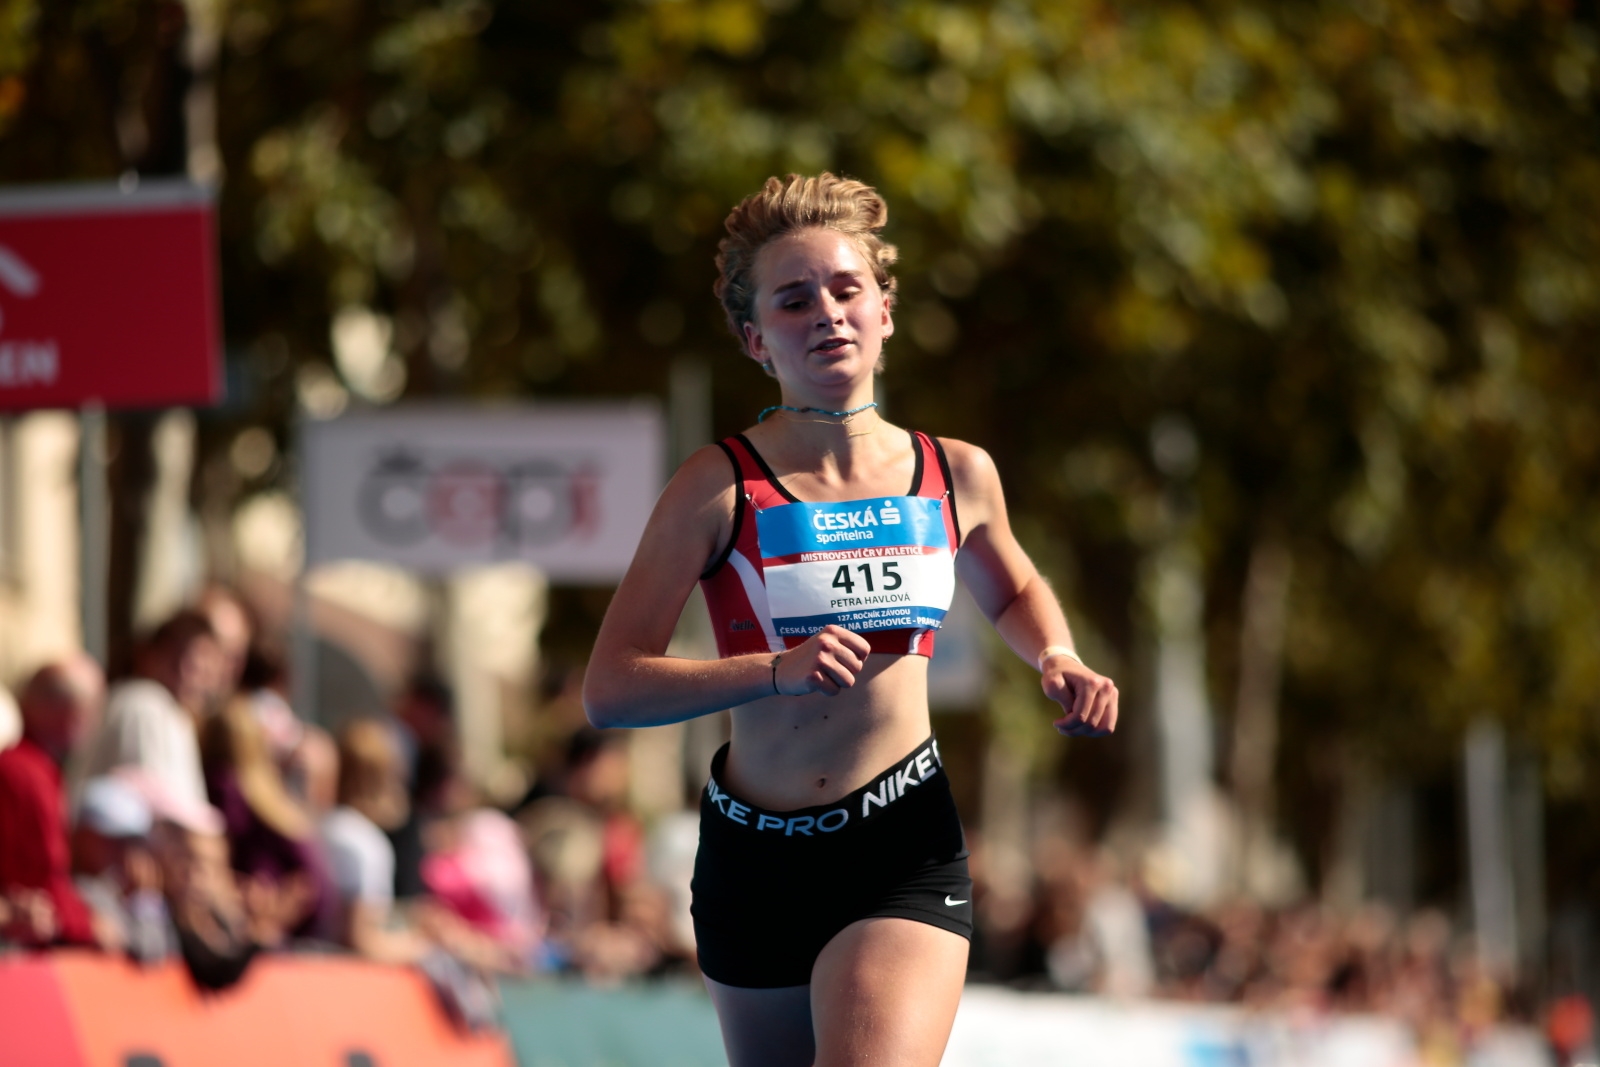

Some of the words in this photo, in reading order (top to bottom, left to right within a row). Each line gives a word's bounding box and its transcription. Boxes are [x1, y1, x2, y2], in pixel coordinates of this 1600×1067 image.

[813, 506, 879, 531] ČESKÁ
[816, 529, 874, 544] spořitelna
[800, 548, 862, 562] MISTROVSTVÍ
[863, 547, 875, 558] ČR
[875, 548, 883, 556] V
[884, 546, 923, 556] ATLETICE
[832, 561, 903, 594] 415
[830, 597, 862, 608] PETRA
[864, 592, 911, 605] HAVLOVÁ
[853, 611, 881, 620] ROČNÍK
[881, 608, 911, 617] ZÁVODU
[780, 626, 807, 634] ČESKÁ
[862, 616, 911, 629] BĚCHOVICE
[708, 776, 752, 826] IKE
[757, 808, 849, 836] PRO
[862, 747, 937, 818] NIKE
